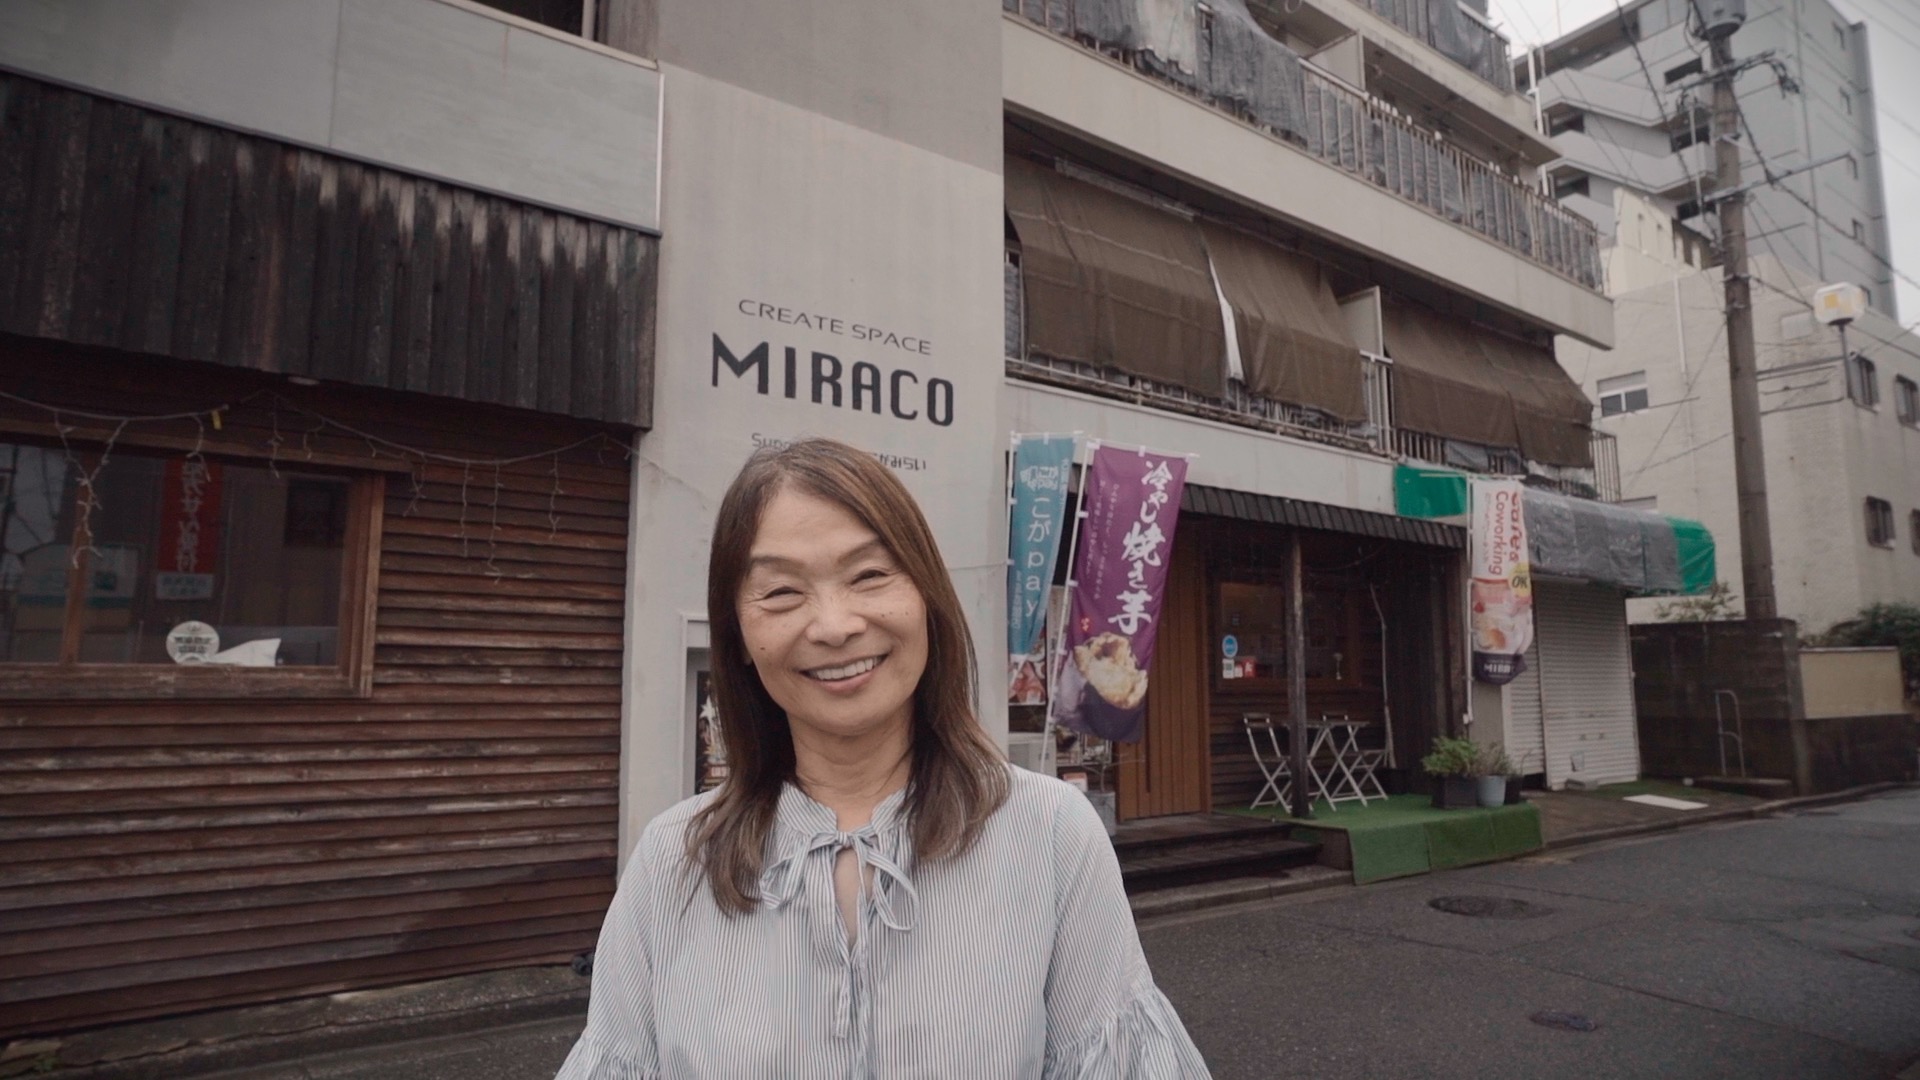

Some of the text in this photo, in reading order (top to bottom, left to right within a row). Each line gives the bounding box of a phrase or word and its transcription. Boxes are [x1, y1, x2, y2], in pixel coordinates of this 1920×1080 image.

[738, 299, 931, 355] CREATE SPACE
[712, 331, 954, 427] MIRACO
[1108, 460, 1173, 635] 冷やし焼き芋
[1488, 491, 1509, 576] Coworking
